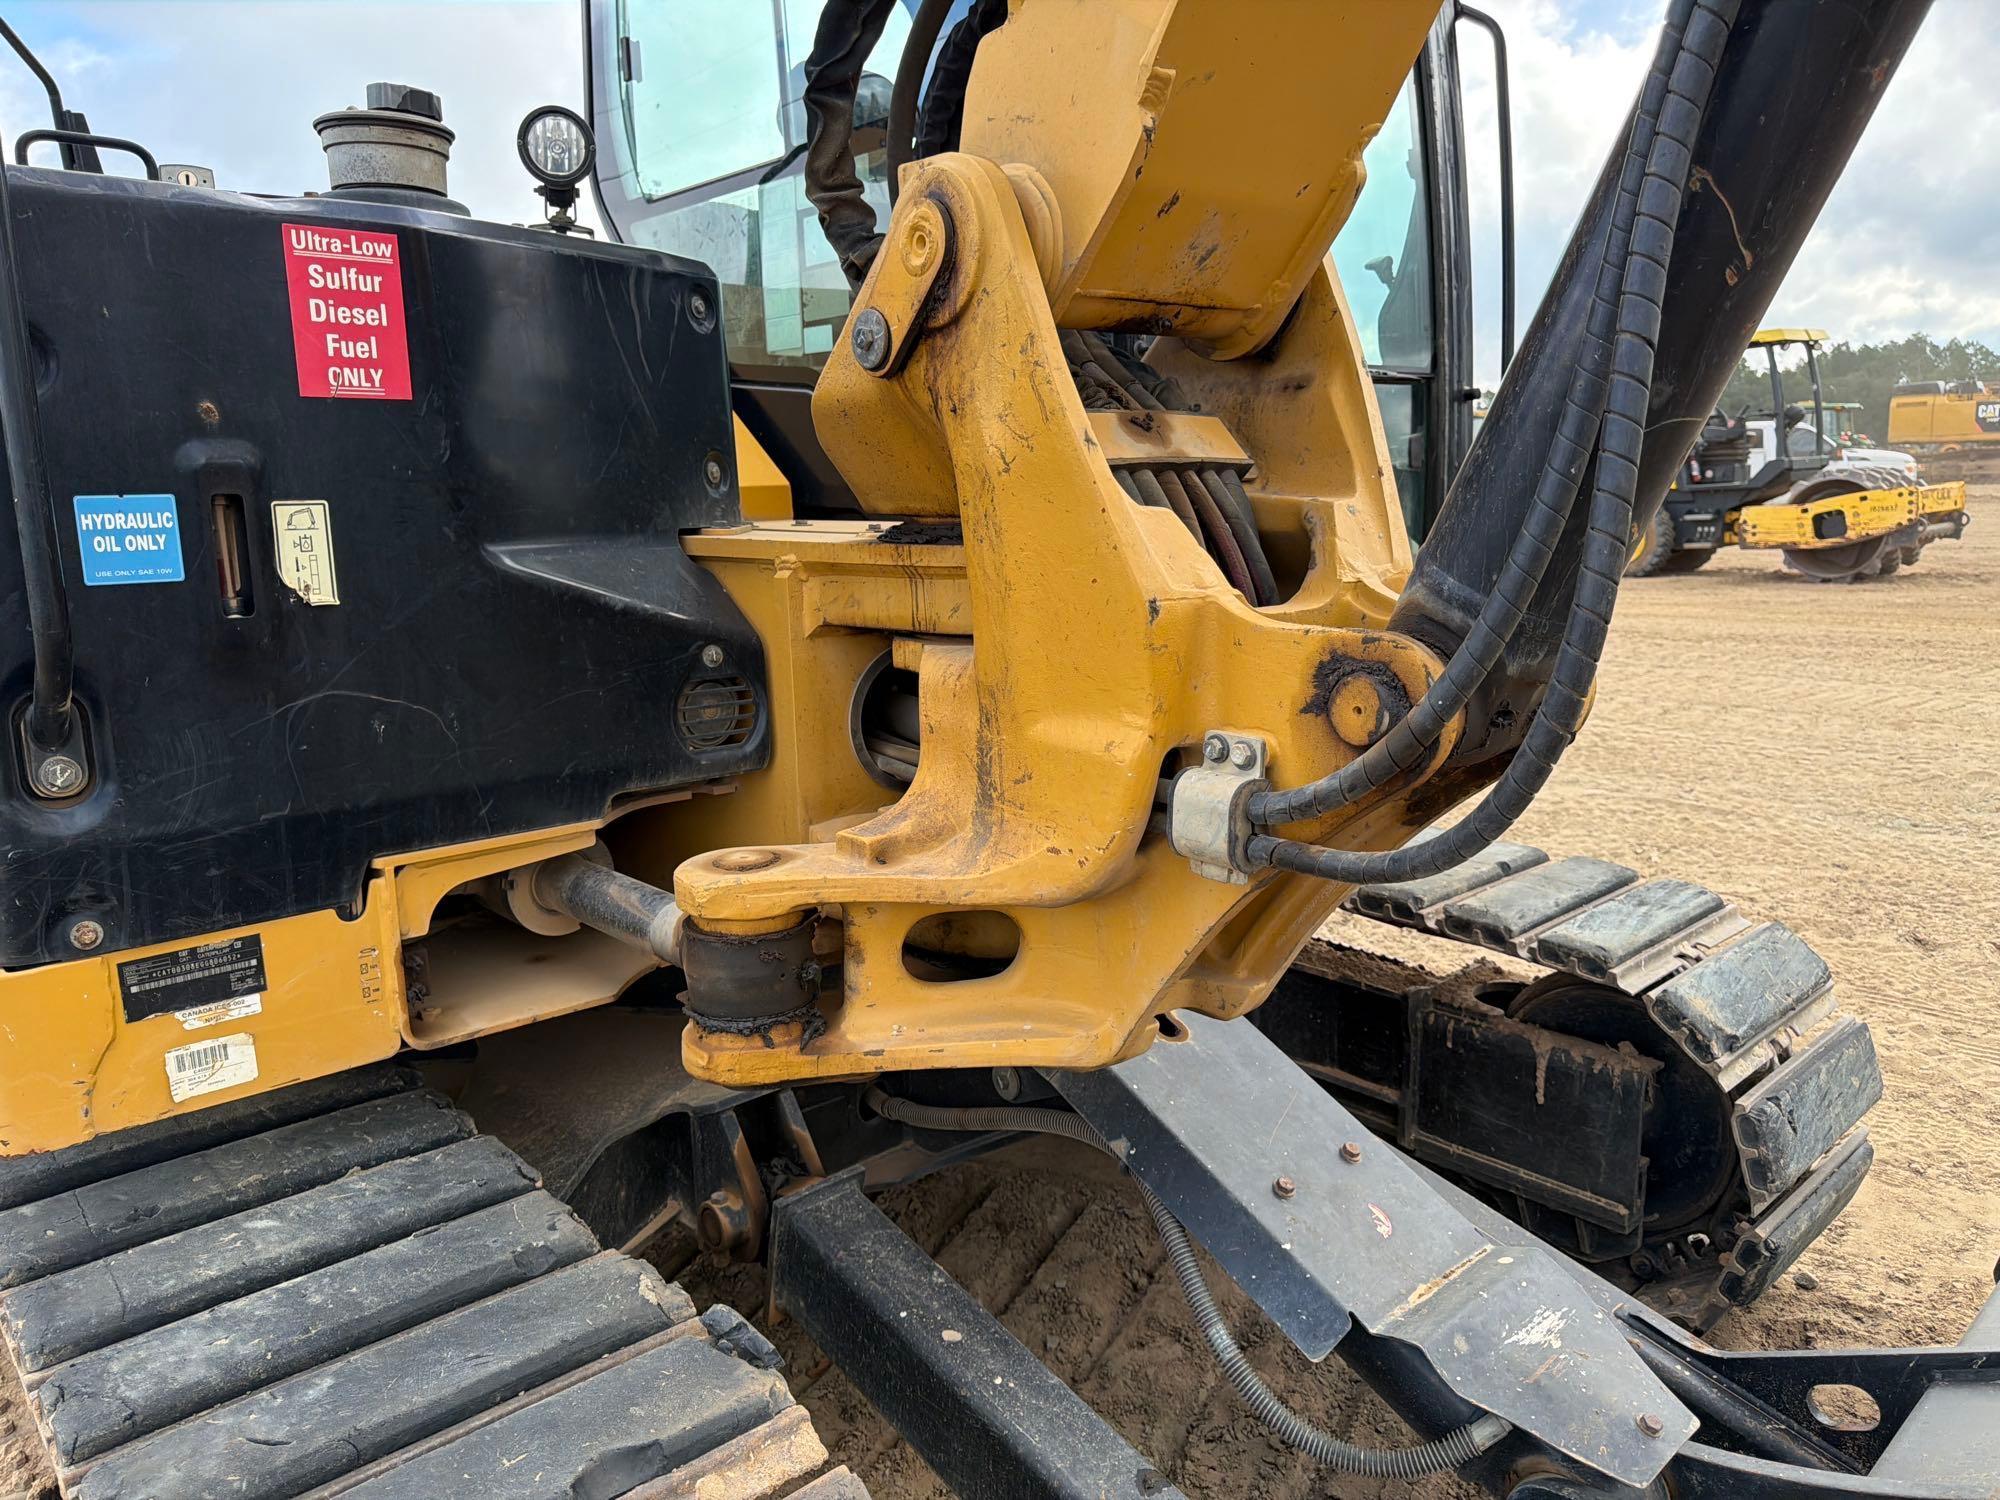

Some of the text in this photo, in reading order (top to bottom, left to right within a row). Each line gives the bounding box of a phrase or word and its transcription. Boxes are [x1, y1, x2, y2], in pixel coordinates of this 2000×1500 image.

[290, 228, 393, 258] Ultra-Low
[307, 264, 383, 293] Sulfur
[309, 298, 388, 327] Diesel
[326, 333, 378, 359] Fuel
[328, 366, 384, 388] ONLY
[1978, 404, 2000, 418] CAT
[80, 511, 174, 531] HYDRAULIC
[93, 533, 167, 553] OIL ONLY
[95, 567, 173, 578] USE ONLY SAE 10W
[181, 1005, 213, 1019] CANADA
